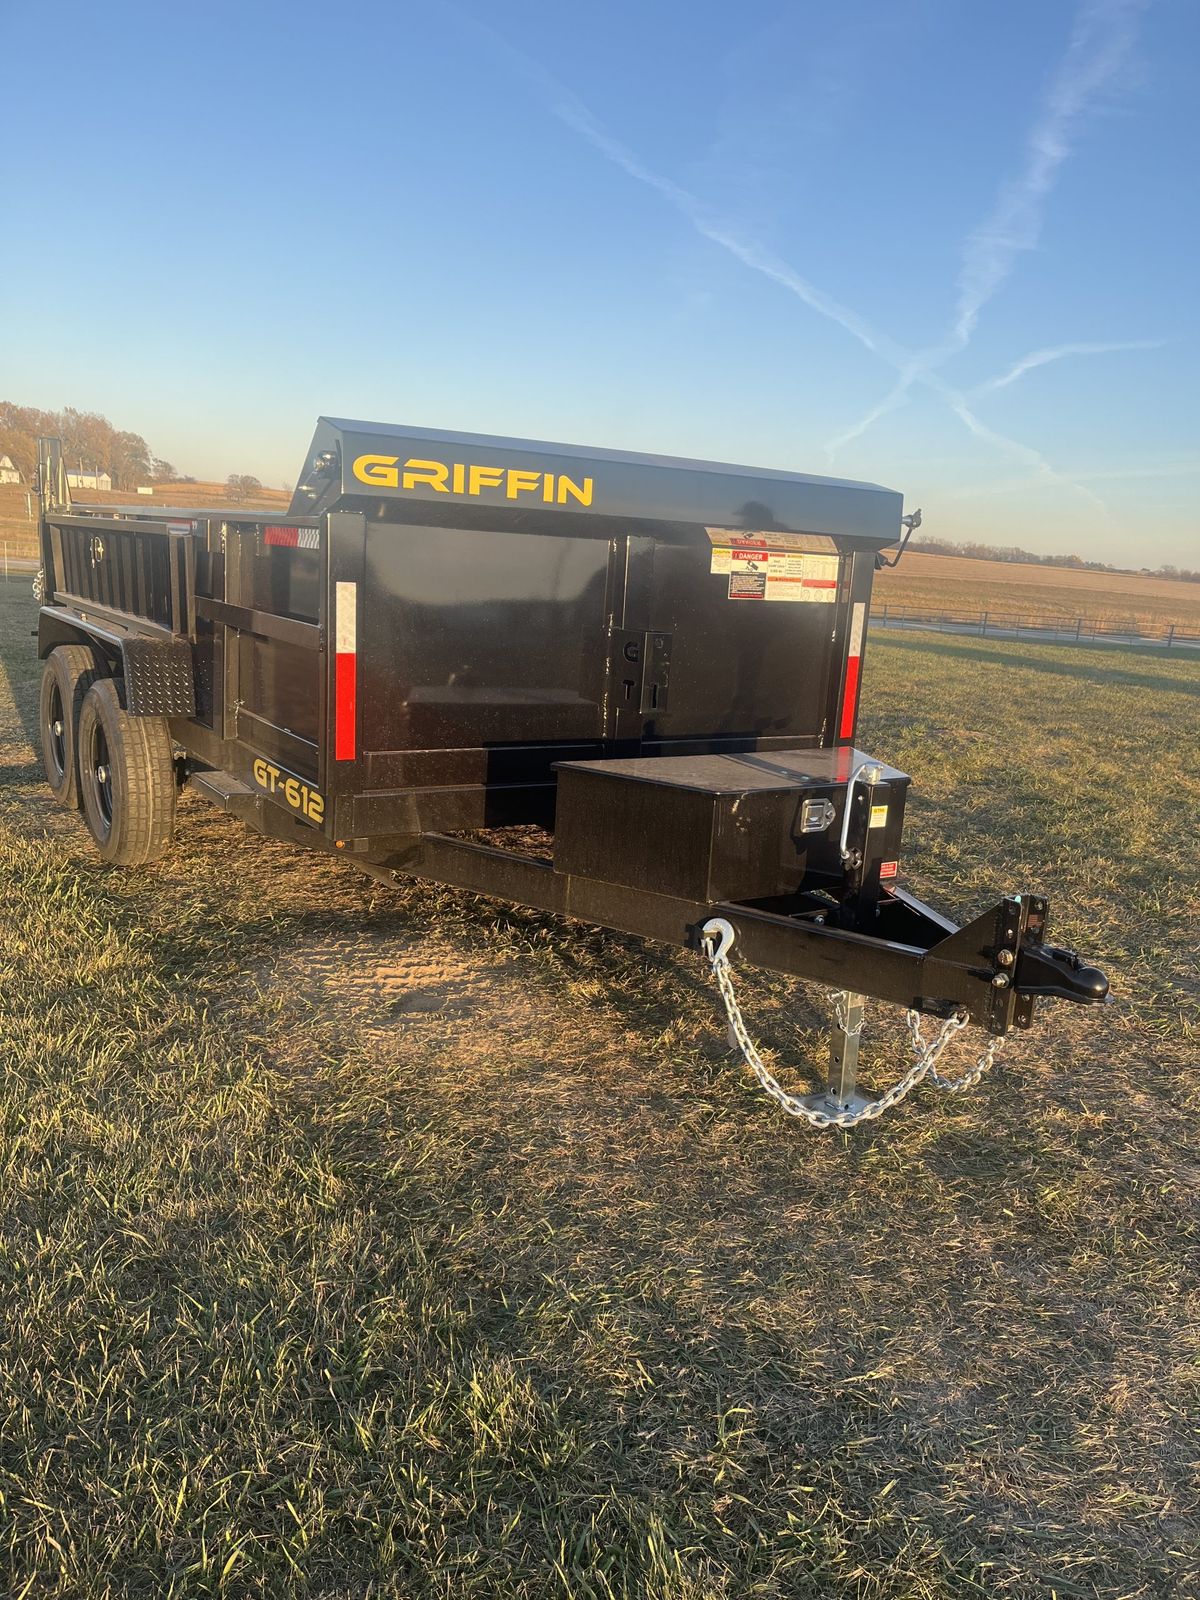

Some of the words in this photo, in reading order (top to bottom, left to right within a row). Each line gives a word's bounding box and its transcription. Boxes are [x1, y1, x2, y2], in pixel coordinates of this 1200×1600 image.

[352, 454, 593, 507] GRIFFIN
[739, 552, 763, 560] DANGER
[253, 758, 325, 824] GT-612
